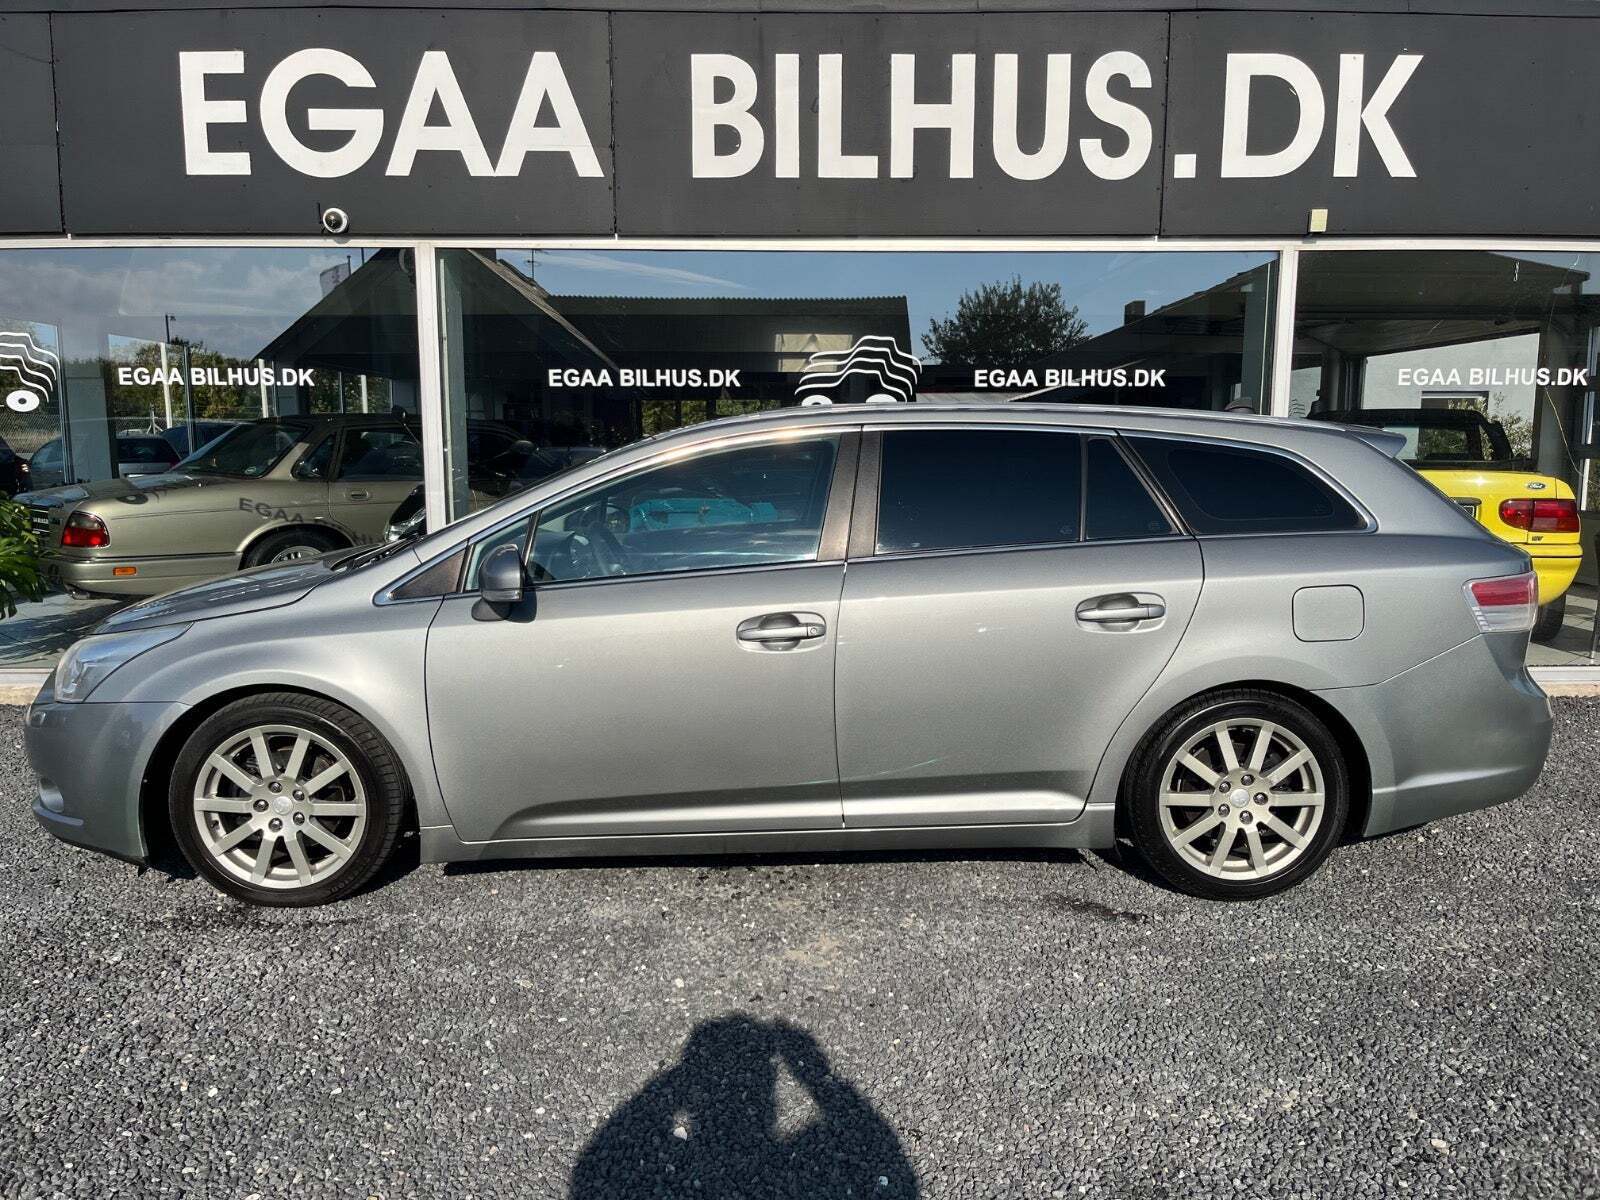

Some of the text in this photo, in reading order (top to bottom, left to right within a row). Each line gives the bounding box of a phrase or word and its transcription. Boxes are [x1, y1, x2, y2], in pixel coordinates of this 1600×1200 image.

[178, 48, 1423, 181] EGAA BILHUS.DK
[118, 367, 315, 387] EGAA BILHUS.DK
[548, 368, 741, 387] EGAA BILHUS.DK
[974, 368, 1166, 387] EGAA BILHUS.DK
[1397, 367, 1588, 386] EGAA BILHUS.DK
[239, 498, 304, 523] EGAA
